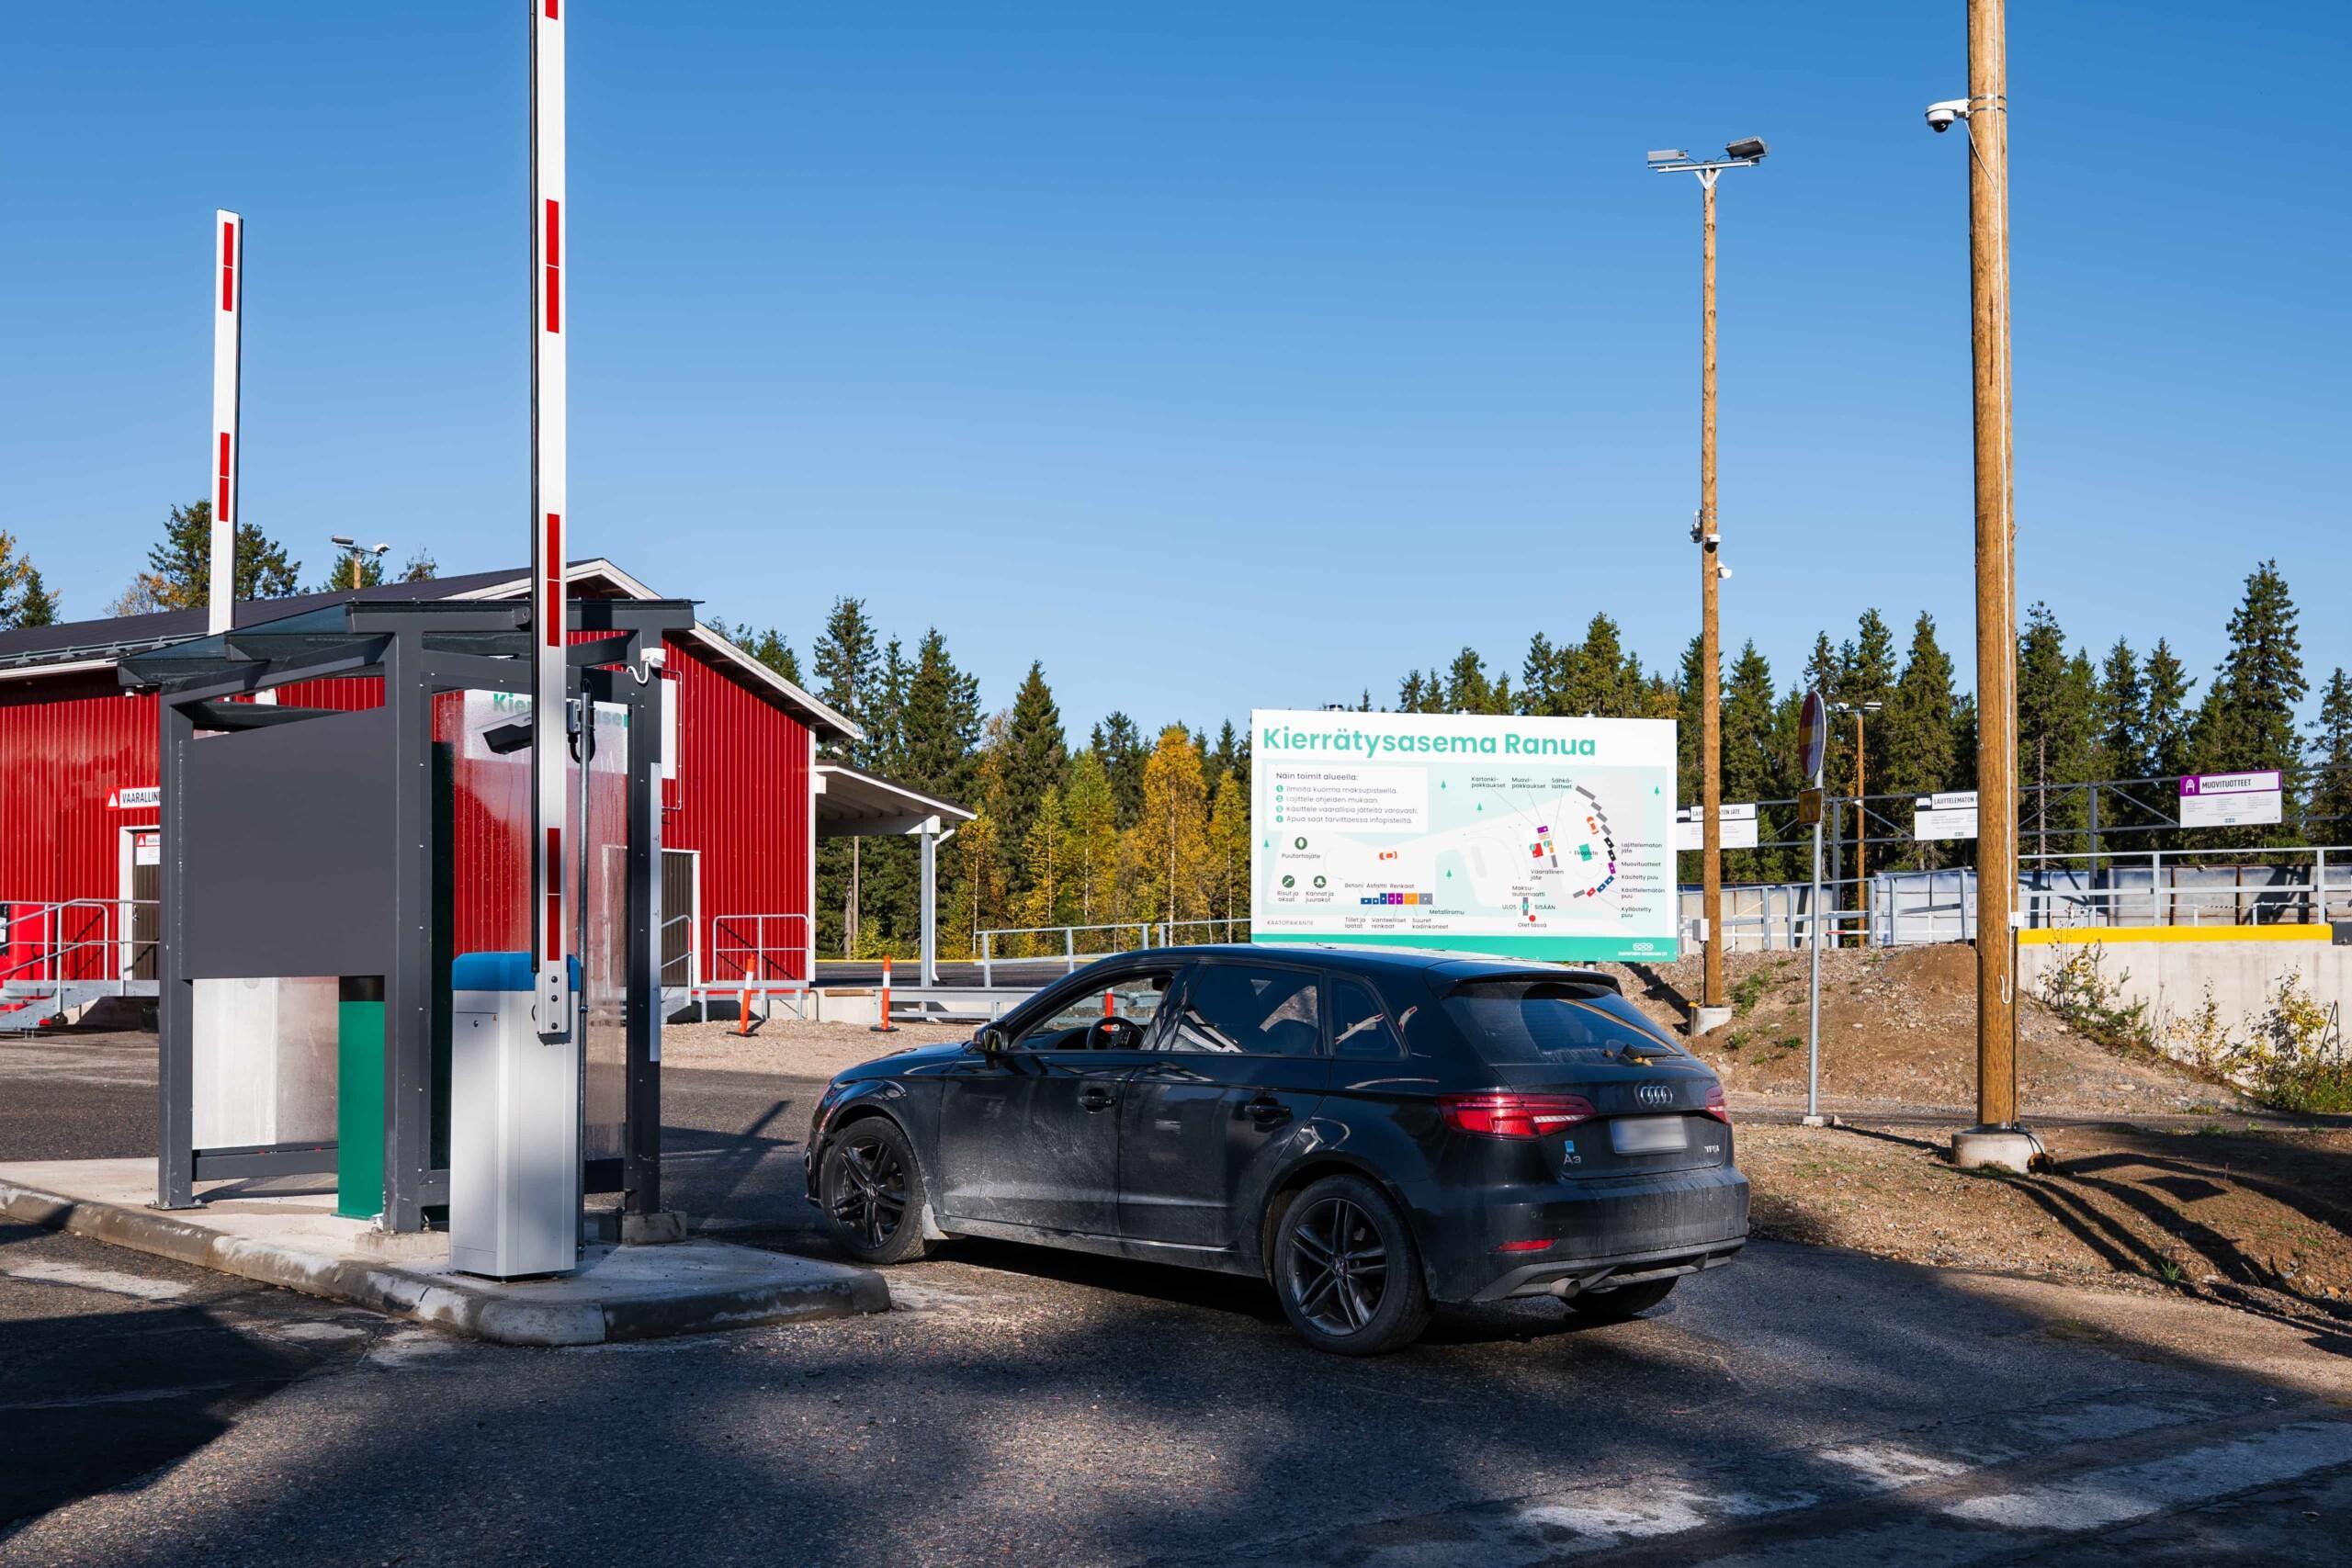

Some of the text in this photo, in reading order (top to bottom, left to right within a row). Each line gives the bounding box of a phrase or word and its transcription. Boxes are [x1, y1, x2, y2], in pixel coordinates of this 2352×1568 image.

[1263, 727, 1596, 758] Kierrätysasema Ranua
[1276, 772, 1295, 780] Näin
[1323, 773, 1358, 781] alueella:
[2202, 779, 2251, 788] MUOVITUOTTEET
[1564, 1154, 1580, 1165] A3
